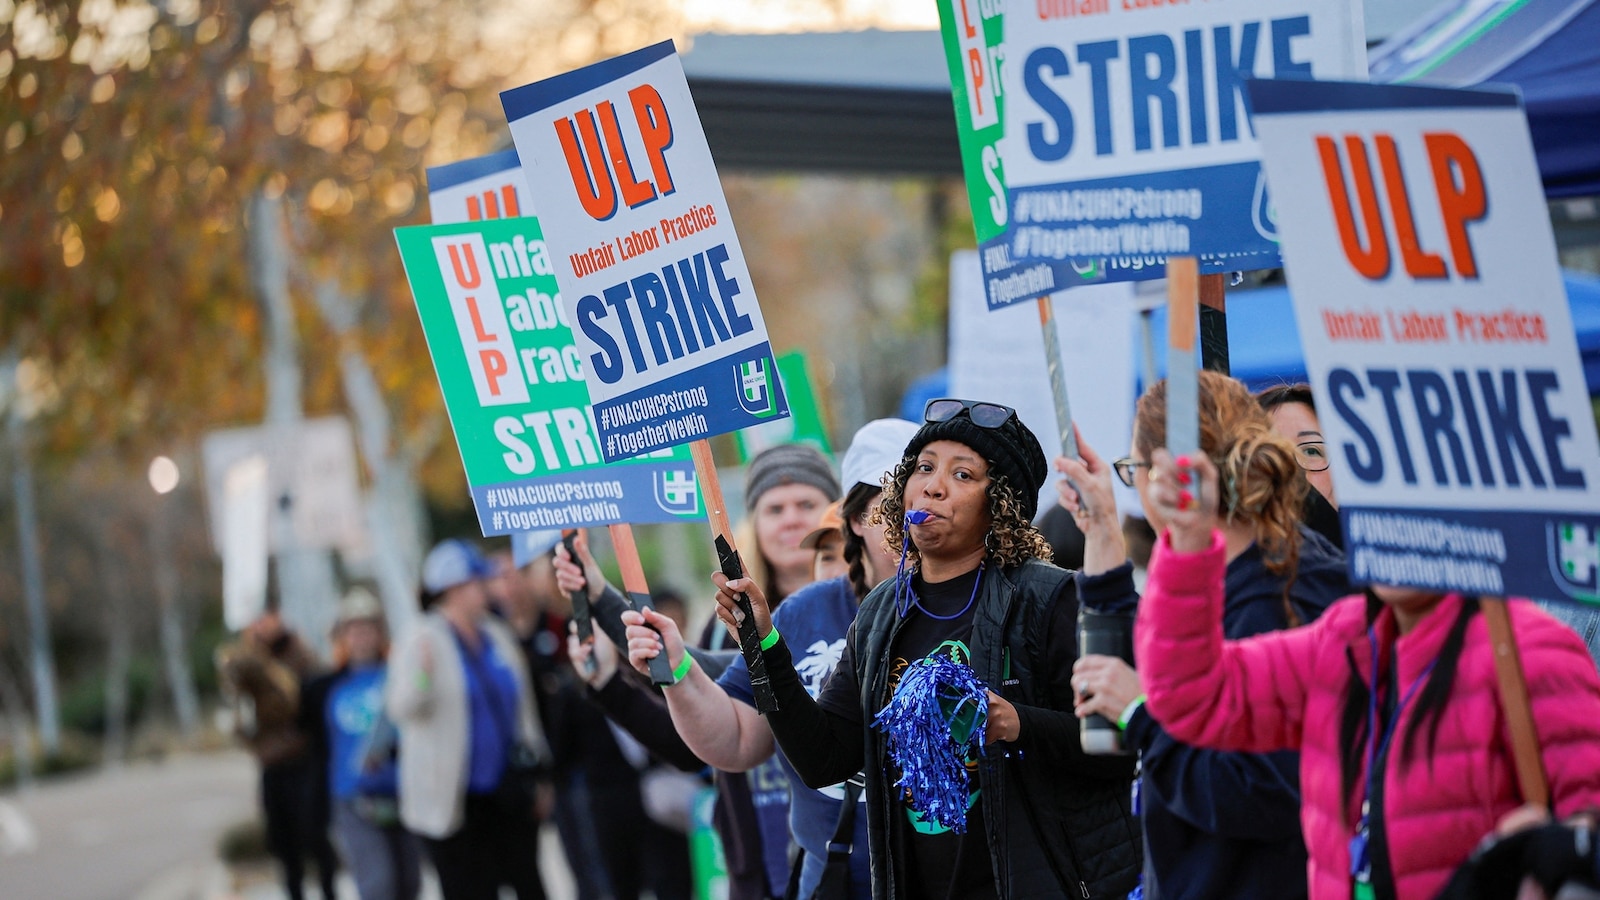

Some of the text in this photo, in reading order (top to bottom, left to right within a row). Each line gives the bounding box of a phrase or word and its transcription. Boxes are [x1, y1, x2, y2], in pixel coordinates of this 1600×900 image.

[1023, 15, 1312, 163] STRIKE
[553, 83, 675, 221] ULP
[569, 203, 718, 279] Unfair Labor Practice
[1313, 130, 1490, 282] ULP
[576, 243, 754, 384] STRIKE
[1321, 307, 1549, 345] Unfair Labor Practice
[493, 405, 606, 475] STR
[601, 386, 708, 431] #UNACUHCPstrong
[607, 413, 708, 457] #TogetherWeWin
[1327, 368, 1587, 489] STRIKE
[486, 481, 623, 509] #UNACUHCPstrong
[492, 501, 620, 531] #TogetherWeWin
